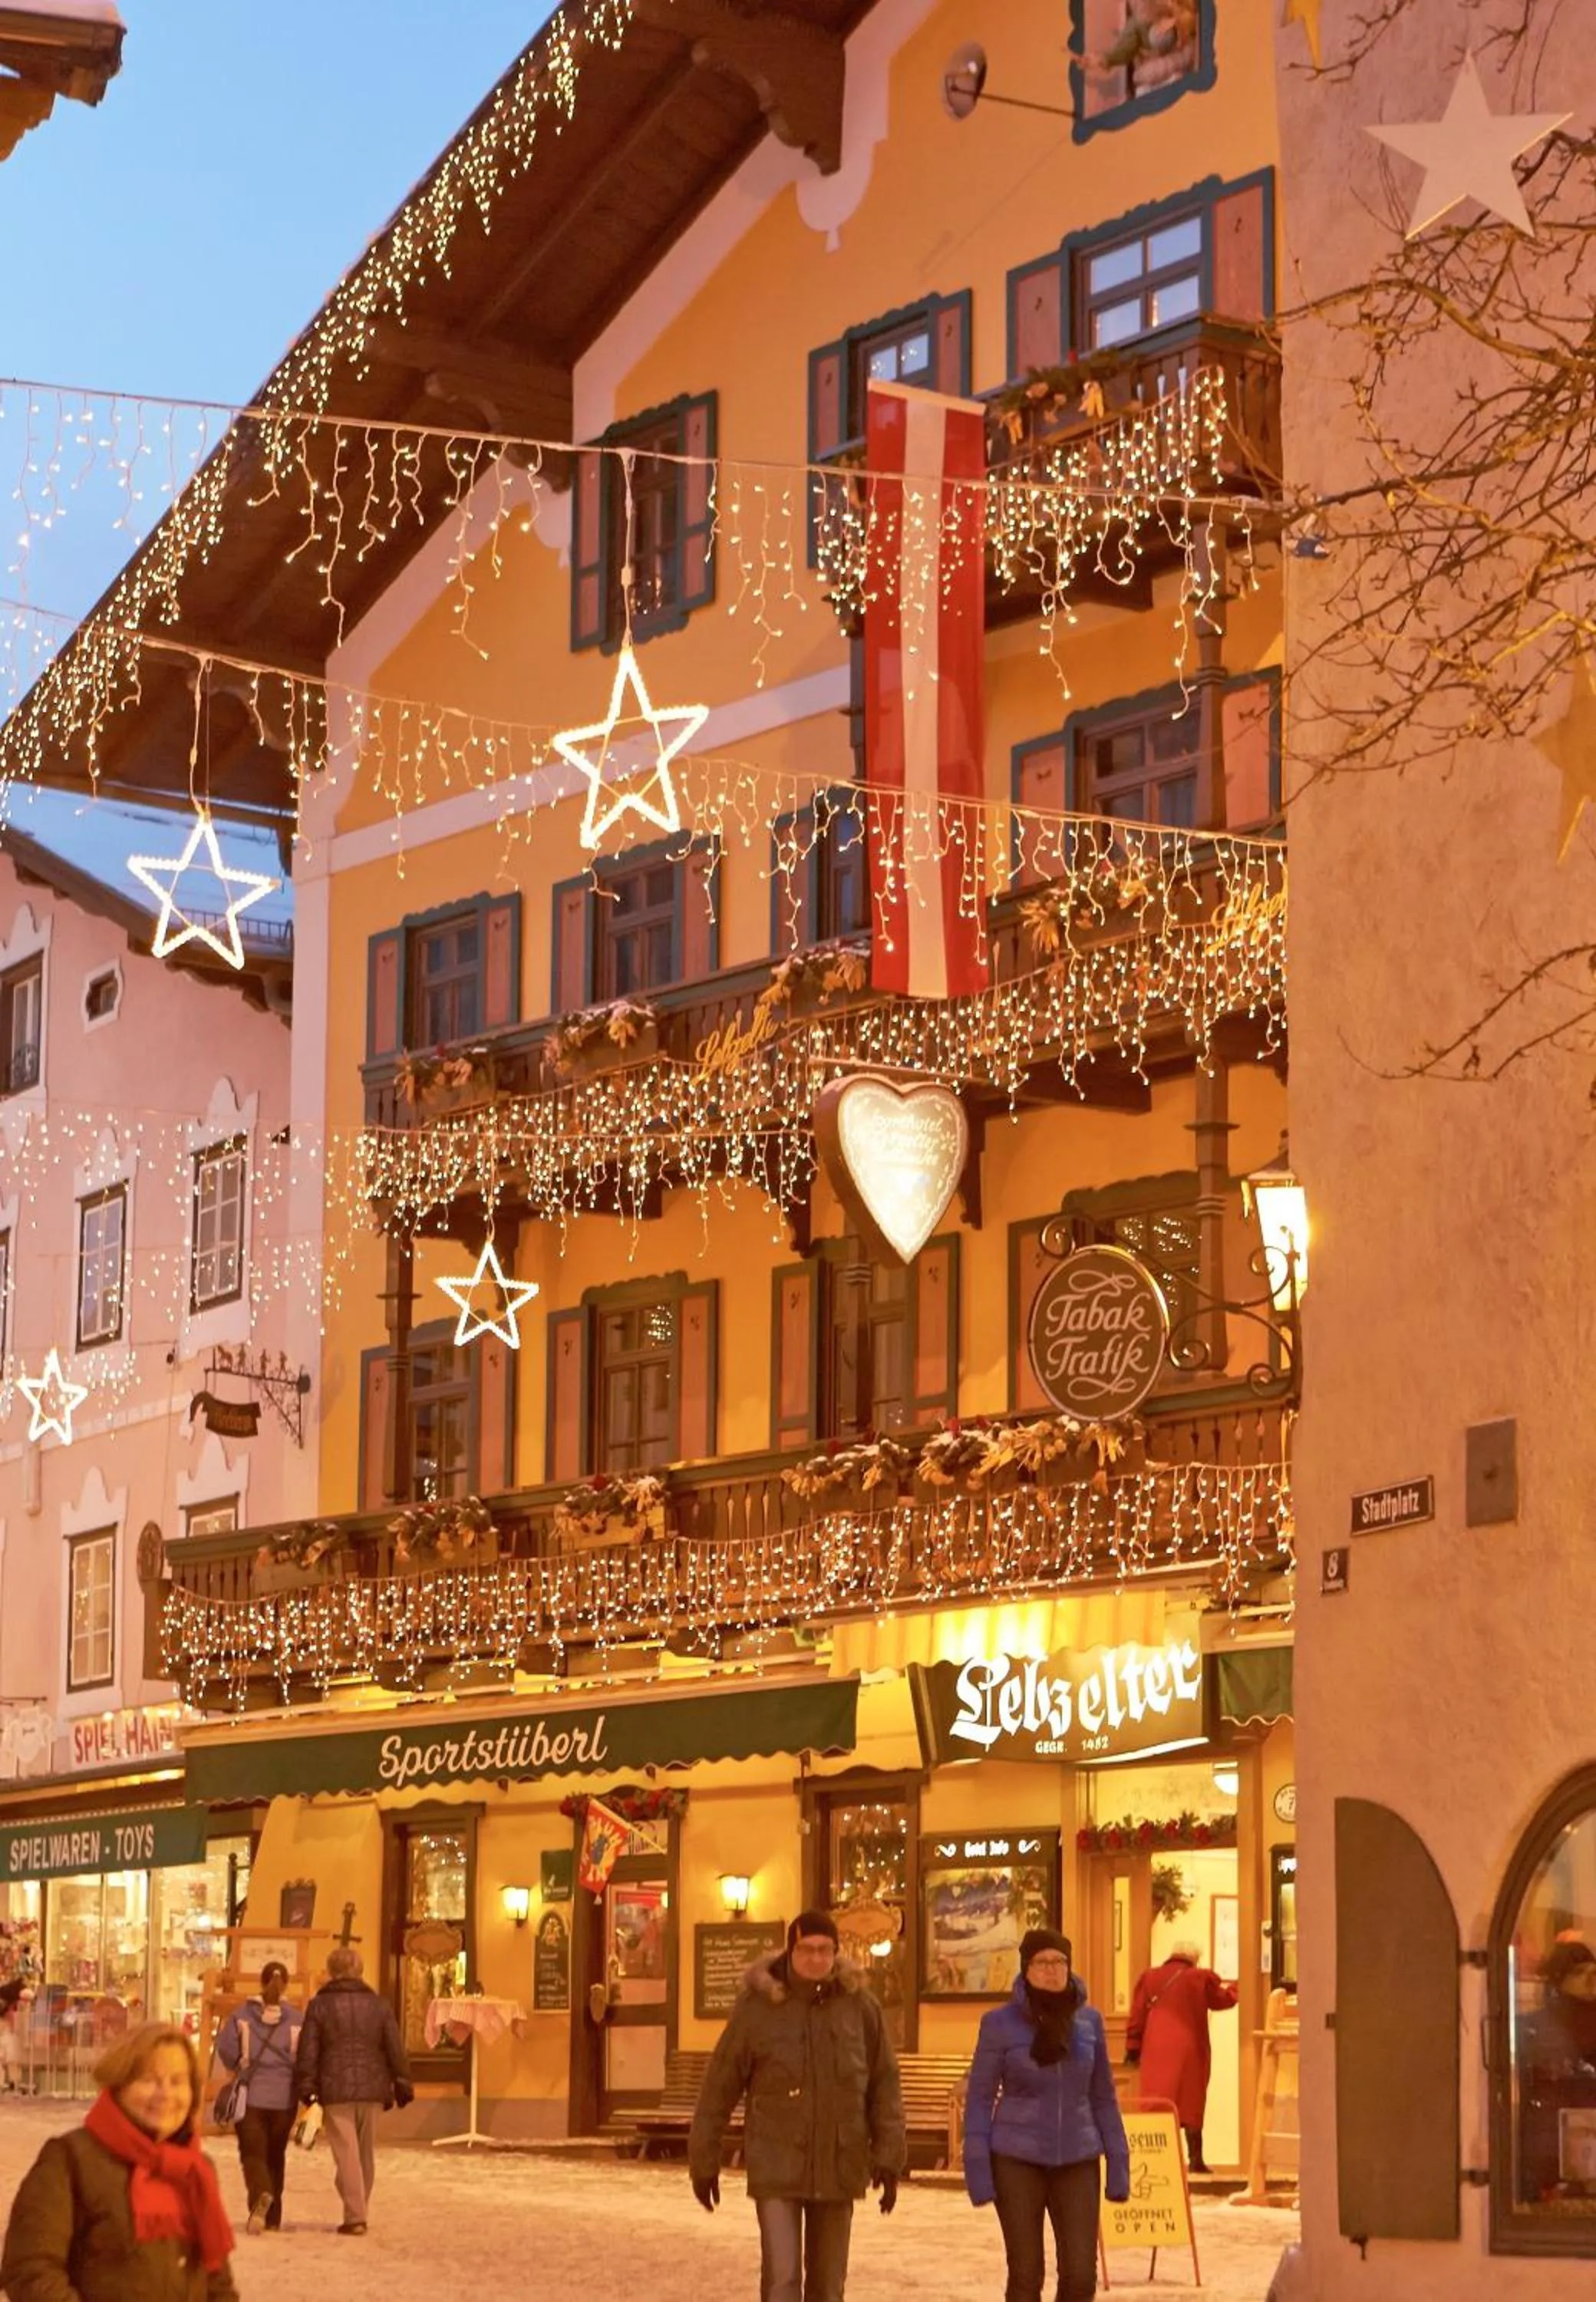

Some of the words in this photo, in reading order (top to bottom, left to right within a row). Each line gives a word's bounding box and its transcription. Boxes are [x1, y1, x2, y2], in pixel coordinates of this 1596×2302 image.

[1044, 1292, 1153, 1337] Tabak
[1044, 1334, 1151, 1381] Trafik
[1361, 1489, 1420, 1524] Stadtplatz
[1327, 1552, 1339, 1578] 8
[949, 1639, 1204, 1753] Lebzelter
[378, 1714, 608, 1787] Sportstüberl
[9, 1829, 101, 1872] SPIELWAREN
[114, 1823, 155, 1862] TOYS
[1129, 2132, 1168, 2149] seum
[1115, 2221, 1176, 2234] OPEN
